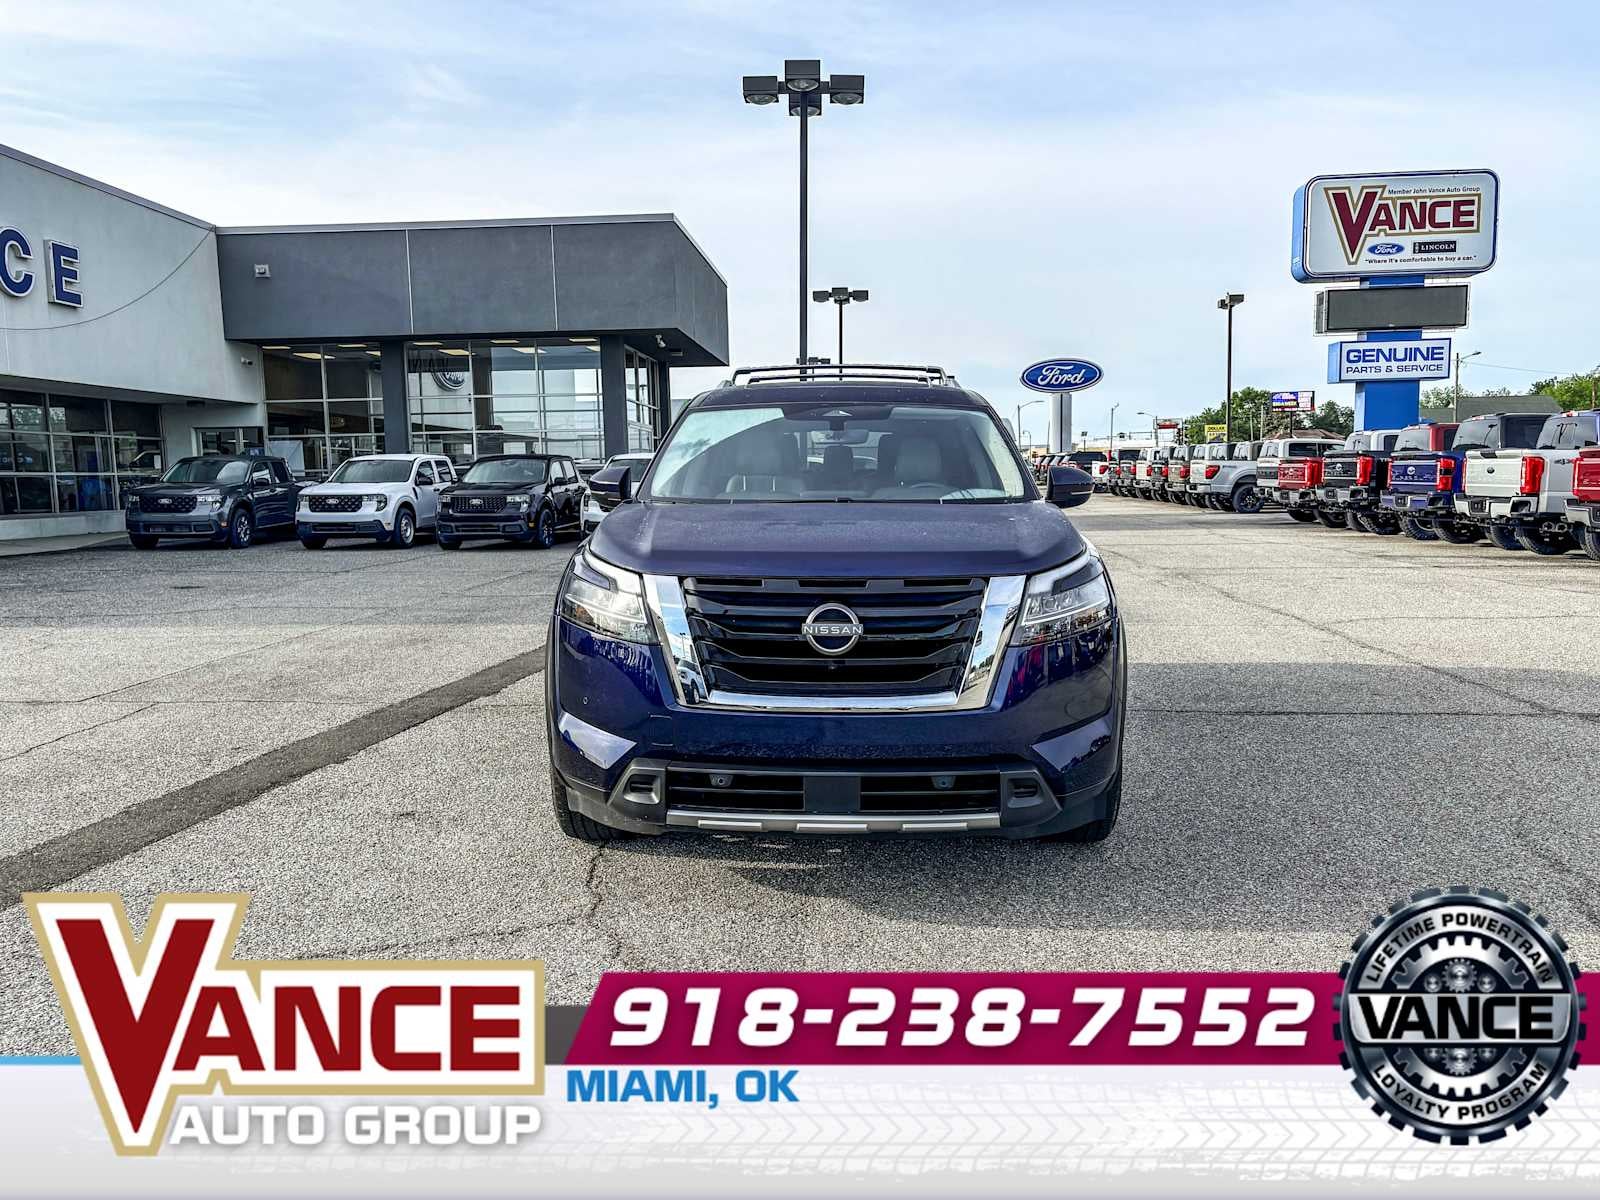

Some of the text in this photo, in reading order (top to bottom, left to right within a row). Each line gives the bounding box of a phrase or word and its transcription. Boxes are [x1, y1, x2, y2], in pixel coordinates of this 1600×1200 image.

[1331, 191, 1476, 257] VANCE
[1374, 244, 1399, 254] Ford
[1421, 243, 1455, 251] LINCOLN
[1346, 346, 1445, 364] GENUINE
[1346, 363, 1443, 374] PARTS & SERVICE
[1037, 365, 1086, 386] Ford
[803, 626, 862, 634] NISSAN
